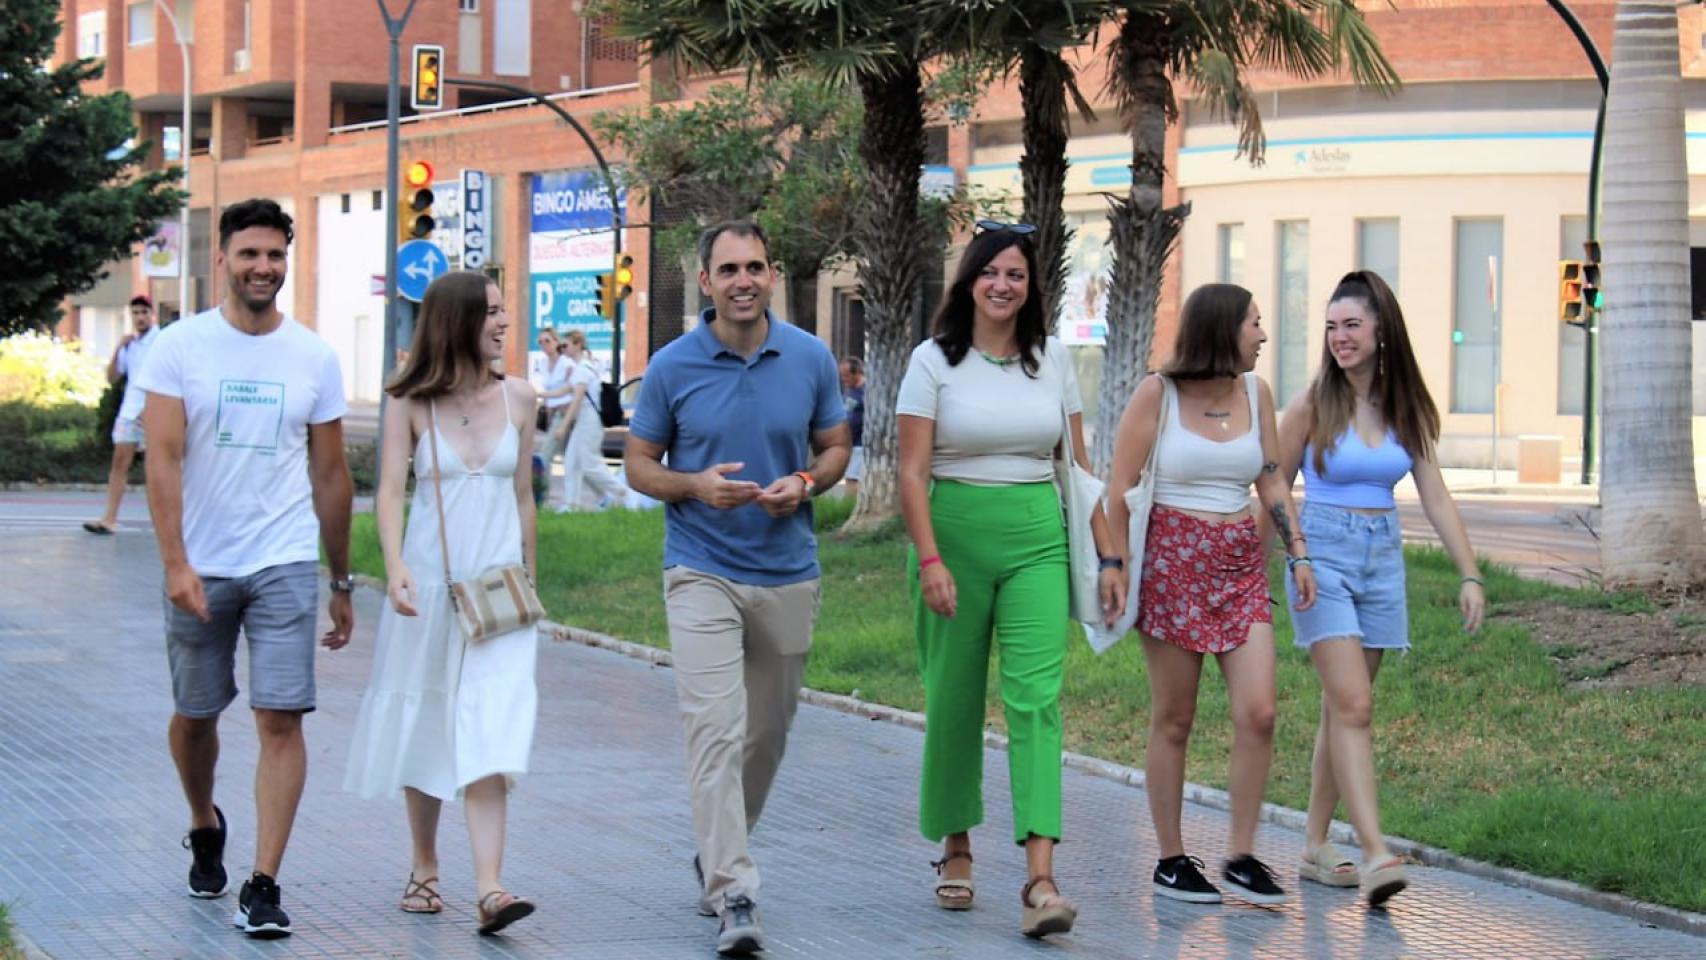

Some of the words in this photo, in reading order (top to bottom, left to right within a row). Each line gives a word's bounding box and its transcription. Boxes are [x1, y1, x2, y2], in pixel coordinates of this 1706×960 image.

[533, 190, 574, 215] BINGO
[575, 186, 626, 212] AMERC
[465, 172, 483, 269] BINGO
[556, 276, 599, 294] APARCA
[536, 281, 554, 329] P
[567, 299, 600, 317] GRAT
